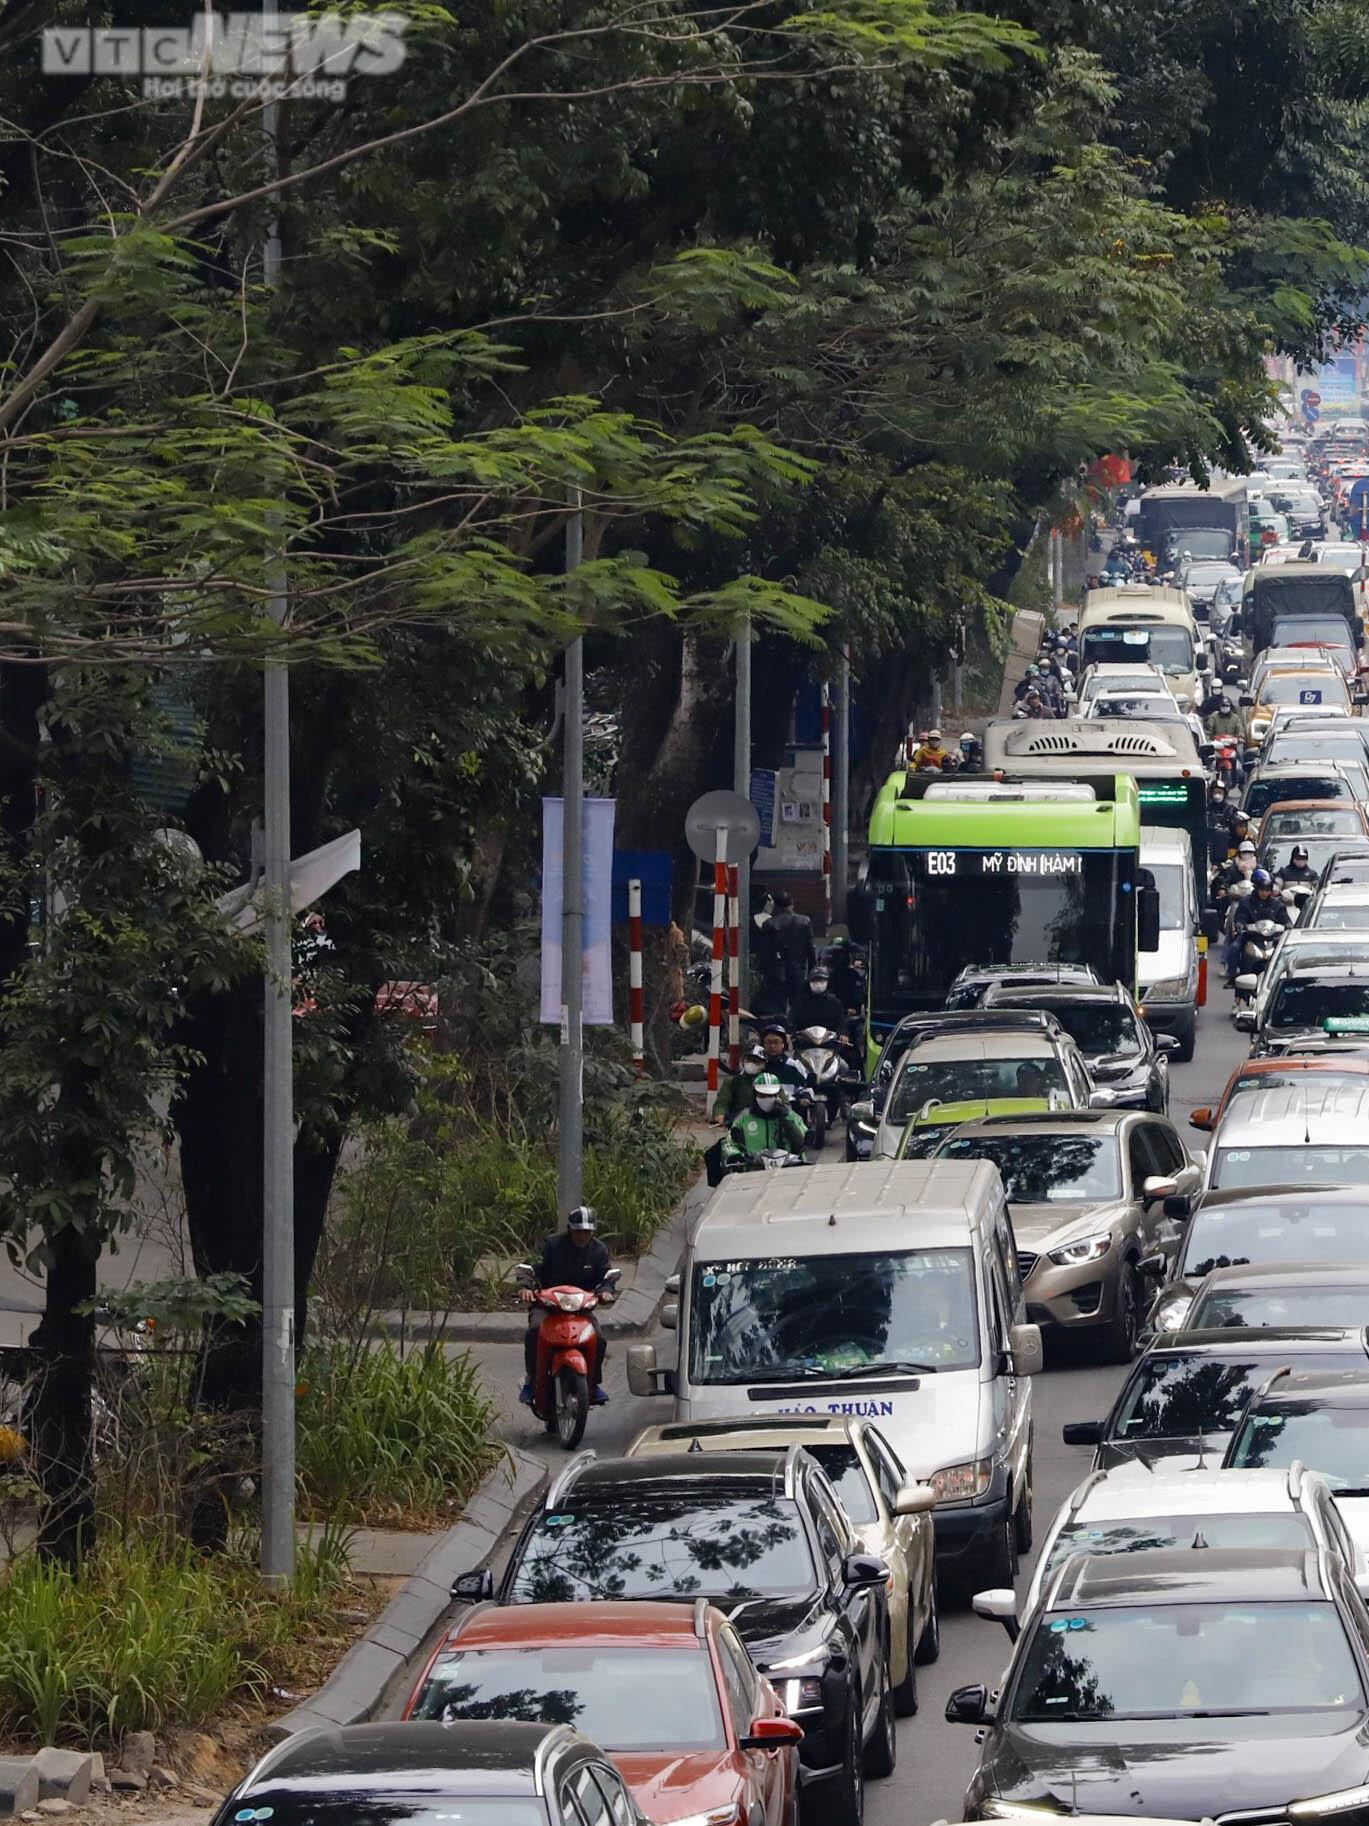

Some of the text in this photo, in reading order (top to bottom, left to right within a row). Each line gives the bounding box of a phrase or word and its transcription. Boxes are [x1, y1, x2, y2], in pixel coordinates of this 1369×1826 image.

[928, 852, 956, 874] E03
[982, 853, 1003, 872] MỸ
[1007, 853, 1037, 872] ĐÌNH
[828, 1399, 893, 1418] THUẬN
